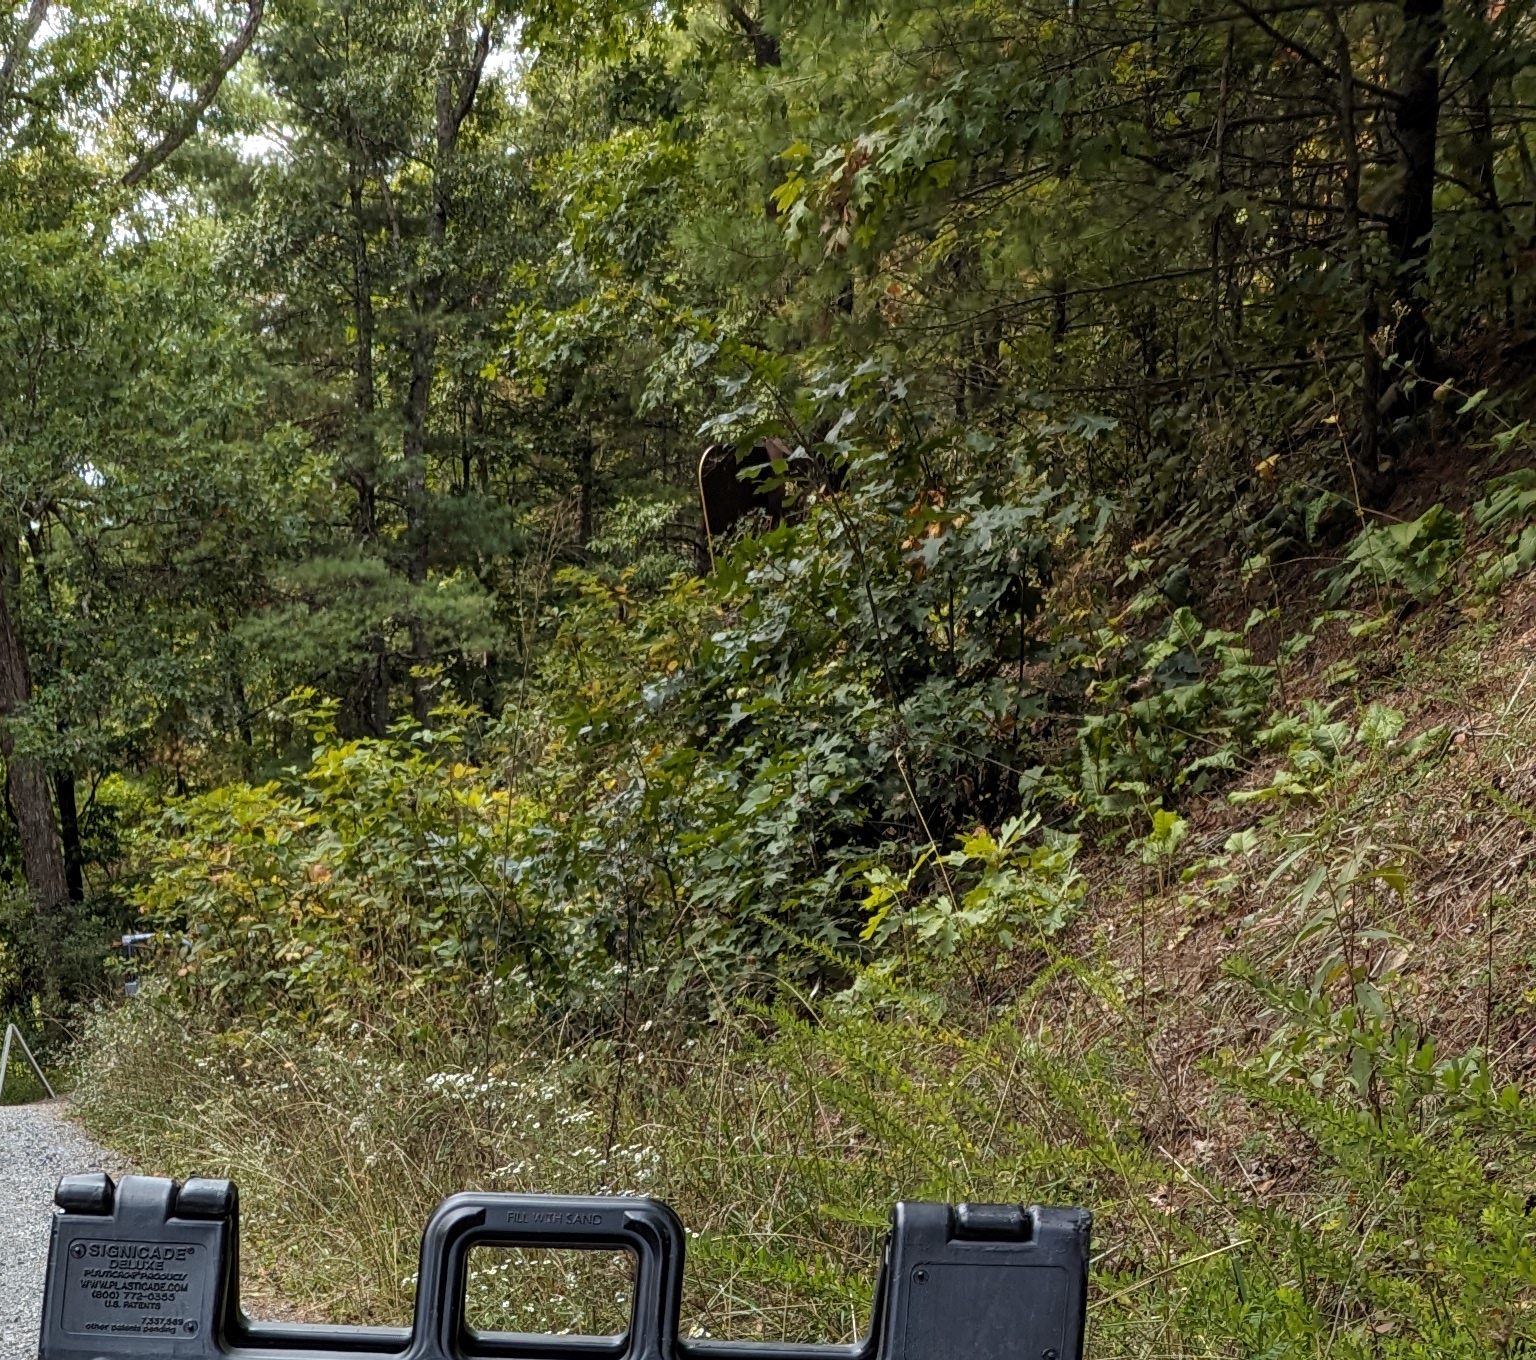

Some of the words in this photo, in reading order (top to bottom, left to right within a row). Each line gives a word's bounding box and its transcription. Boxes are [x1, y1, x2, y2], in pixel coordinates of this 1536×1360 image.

[507, 1211, 528, 1224] FILL
[532, 1212, 563, 1224] WITH
[565, 1213, 603, 1225] SAND
[108, 1259, 165, 1271] DELUXE
[80, 1279, 189, 1292] WWW.PLASTICADE.COM
[91, 1290, 120, 1300] (800)
[123, 1301, 161, 1310] PATENTS
[85, 1322, 109, 1331] other
[111, 1323, 141, 1332] patents
[143, 1325, 177, 1335] pending
